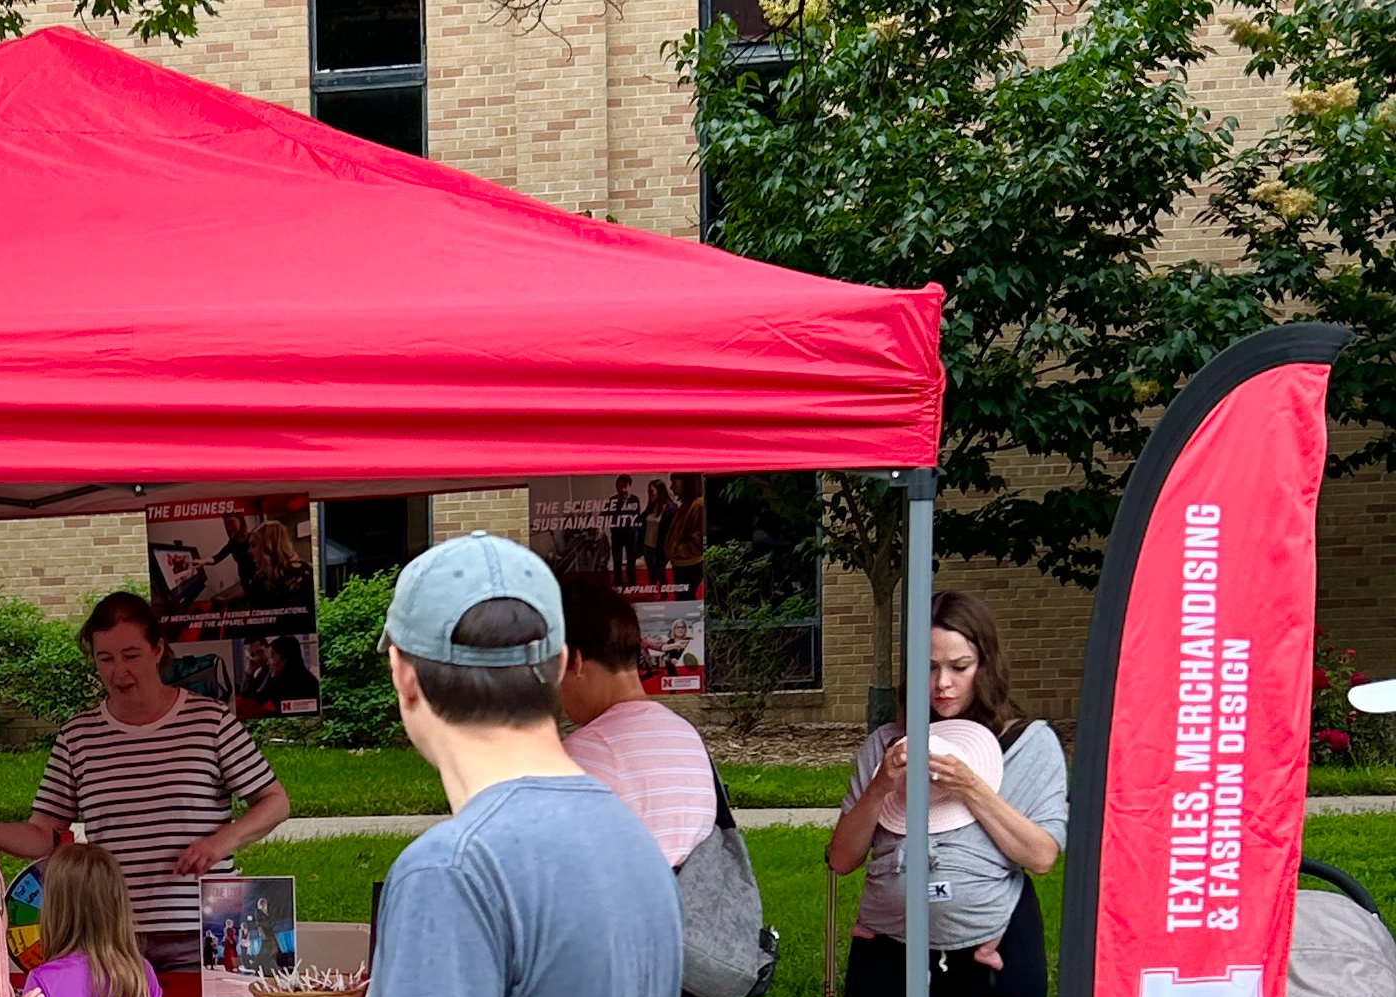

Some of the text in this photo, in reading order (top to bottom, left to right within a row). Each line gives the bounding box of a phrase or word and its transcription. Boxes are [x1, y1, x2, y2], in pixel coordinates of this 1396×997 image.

[147, 505, 170, 520] THE
[535, 499, 638, 515] THE SCIENCE AND
[1166, 503, 1221, 933] TEXTILES, MERCHANDISING
[1207, 639, 1251, 931] & FASHION DESIGN
